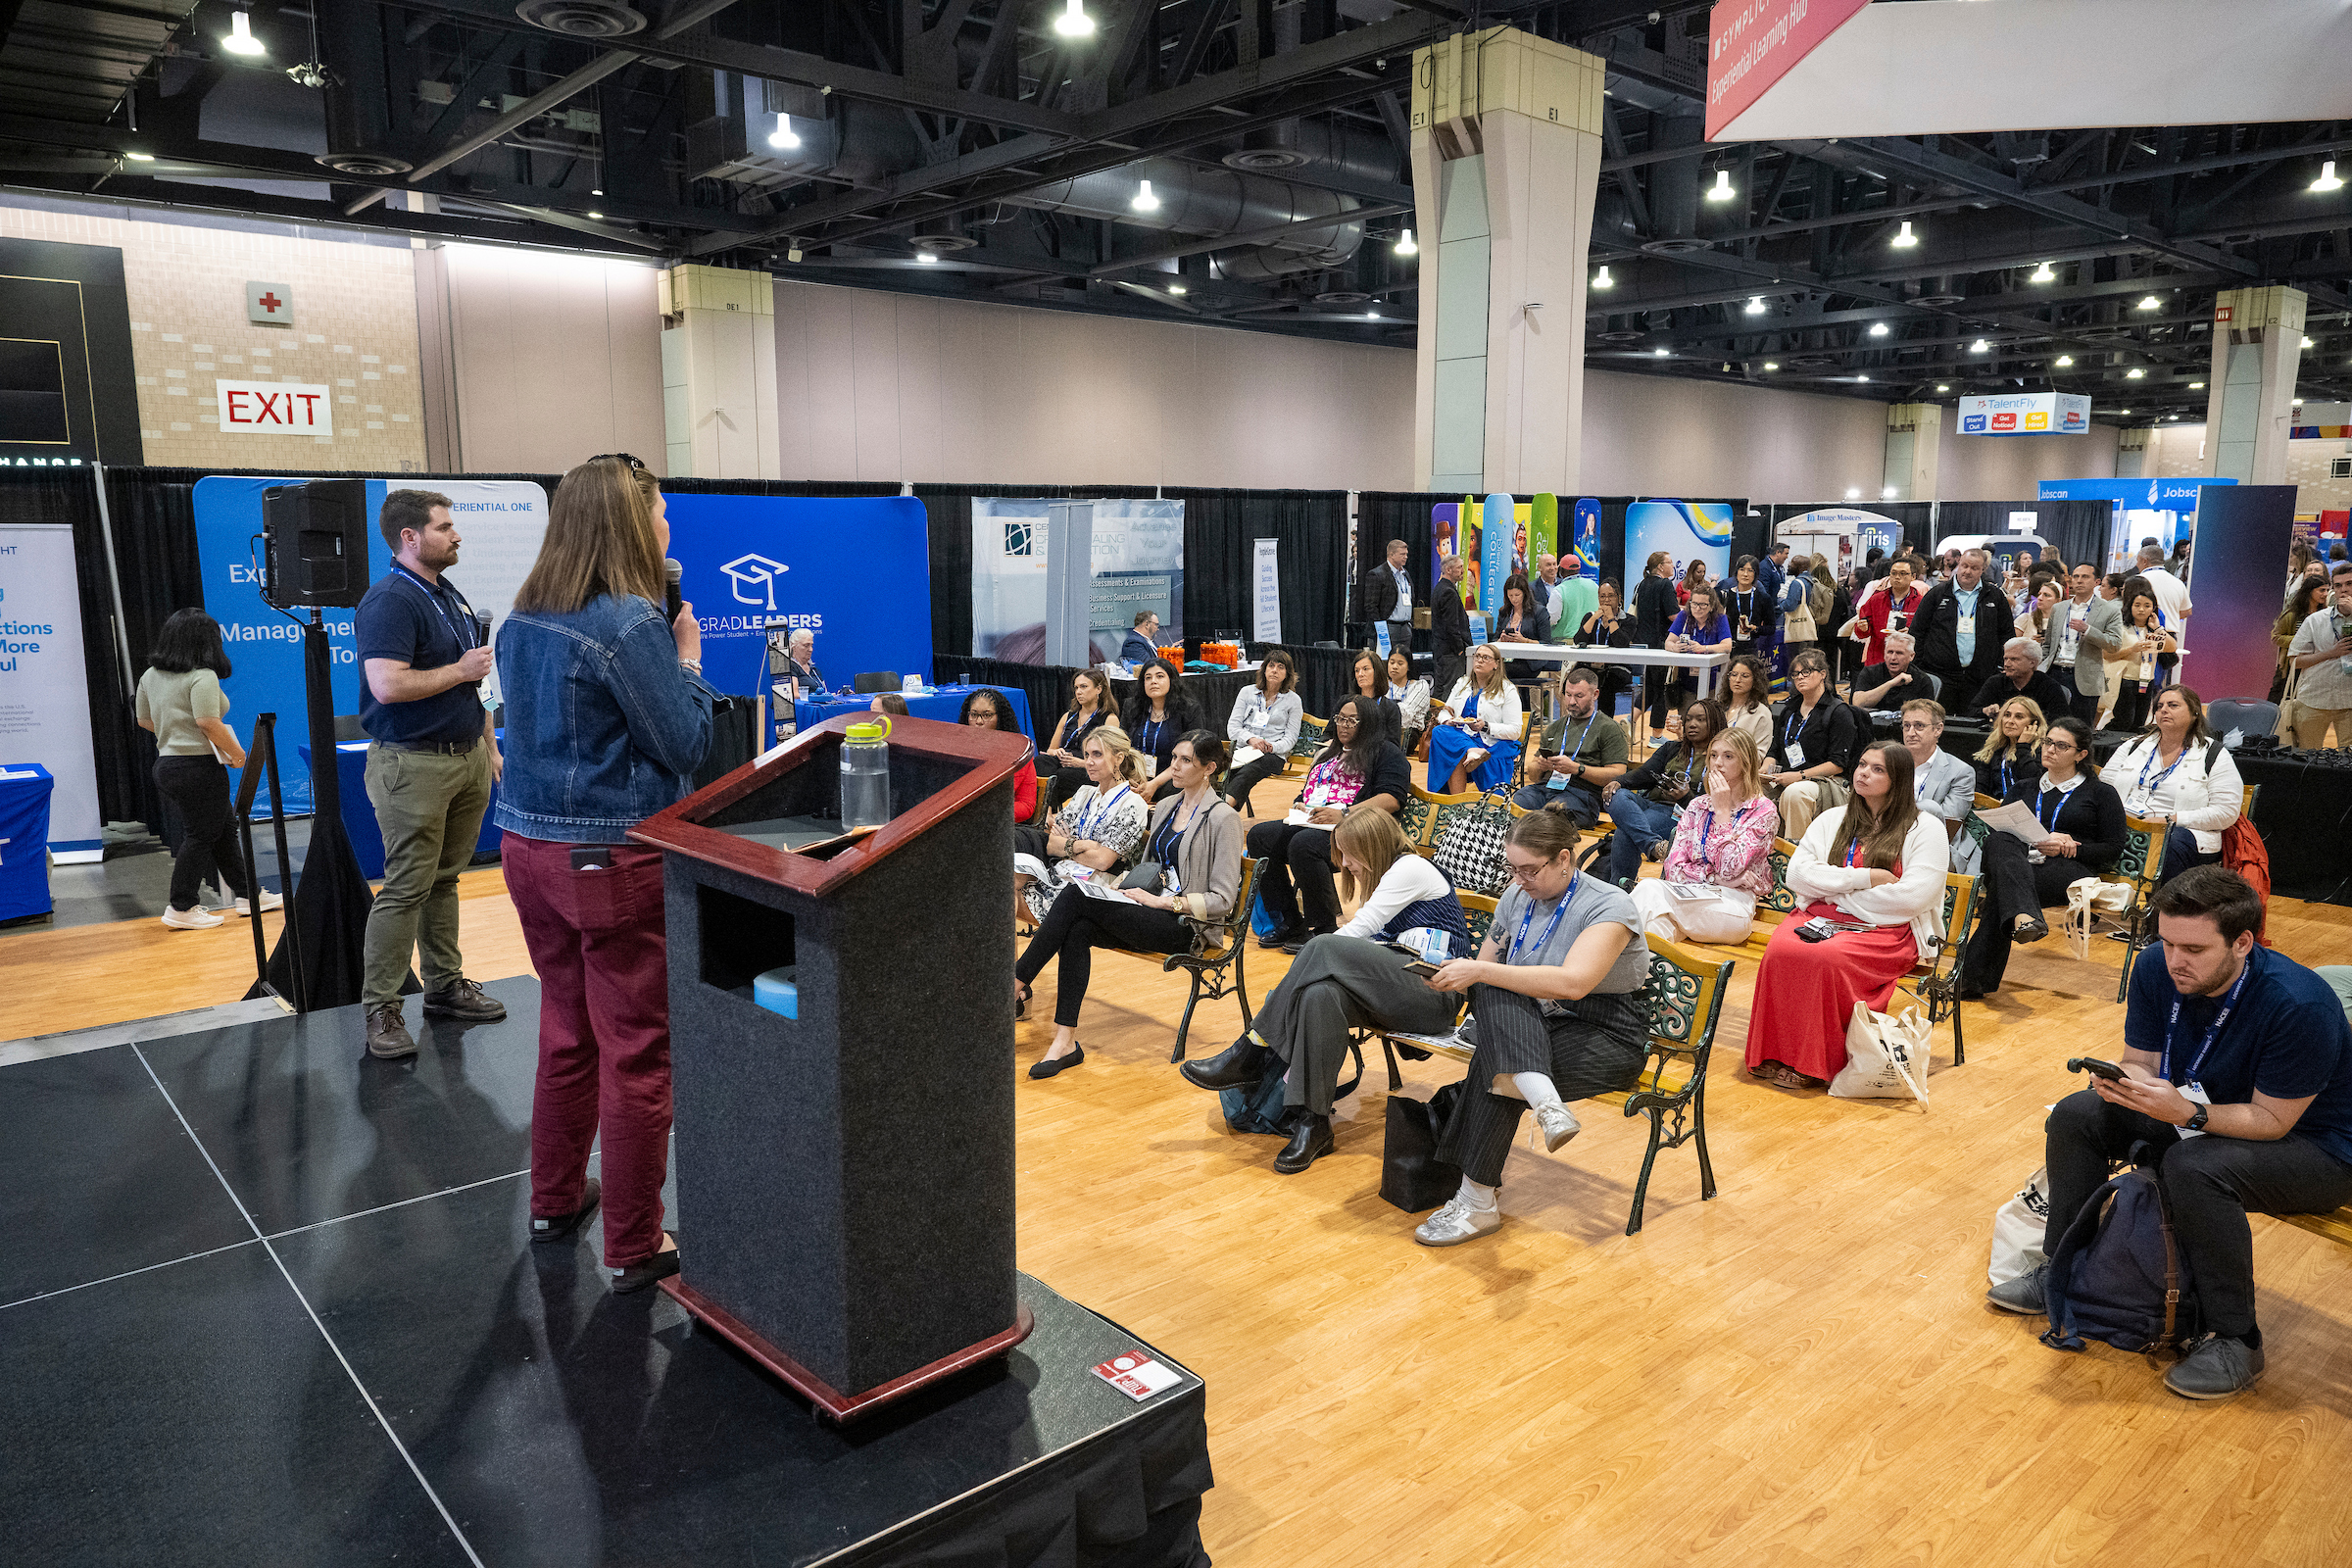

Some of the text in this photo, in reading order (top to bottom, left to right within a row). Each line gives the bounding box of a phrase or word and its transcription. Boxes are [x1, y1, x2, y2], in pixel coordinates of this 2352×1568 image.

[1712, 0, 1808, 105] Experiential Learning Hub
[1548, 107, 1558, 122] E1
[227, 391, 320, 426] EXIT
[1988, 398, 2037, 410] TalentFly
[2041, 489, 2068, 499] Jobscan
[511, 502, 533, 512] ONE
[1868, 530, 1890, 546] iris
[1488, 531, 1497, 595] COLLEGE
[1130, 577, 1165, 586] Examinations
[1113, 592, 1135, 603] Support
[1141, 591, 1167, 600] Licensure
[1090, 604, 1114, 612] Services
